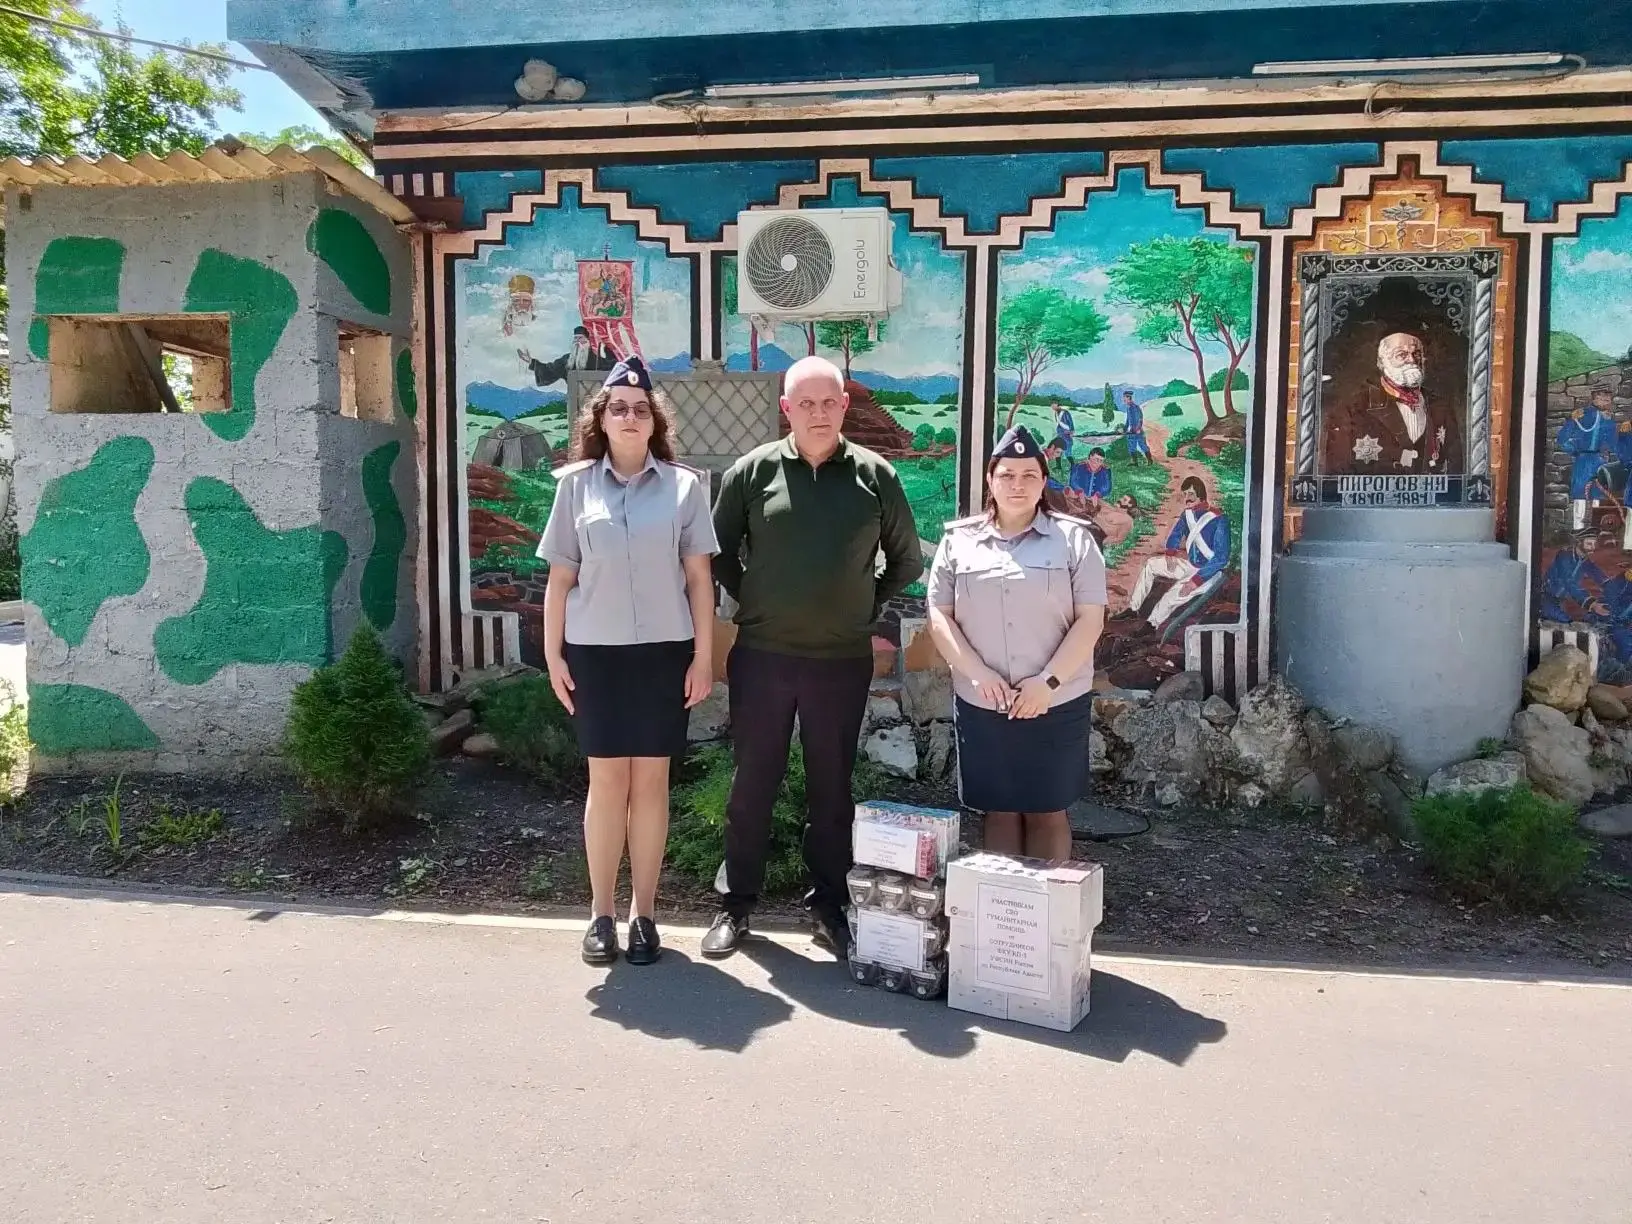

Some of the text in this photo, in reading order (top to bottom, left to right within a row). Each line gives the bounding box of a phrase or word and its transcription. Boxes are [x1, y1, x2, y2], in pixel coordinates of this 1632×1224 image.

[1339, 475, 1419, 492] ПИРОГОВ
[991, 898, 1034, 911] УЧАСТНИКАМ
[986, 913, 1038, 929] ГУМАНИТАРНАЯ
[996, 923, 1026, 934] ПОМОЩЬ
[989, 938, 1035, 952] СОТРУДНИКОВ
